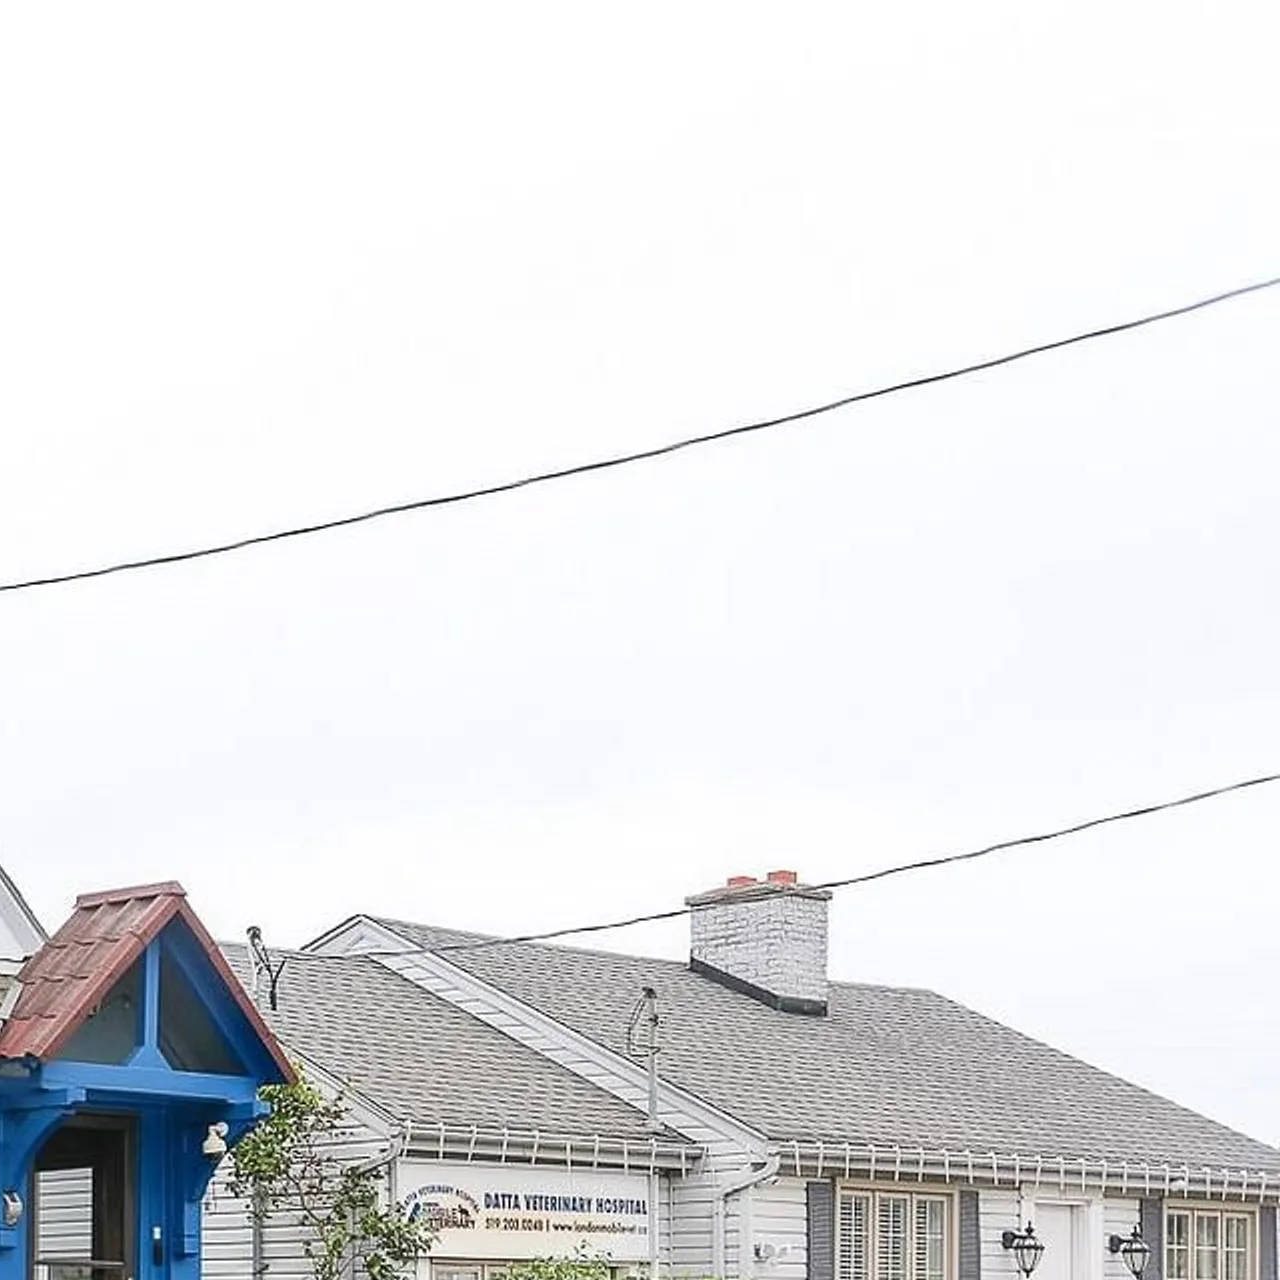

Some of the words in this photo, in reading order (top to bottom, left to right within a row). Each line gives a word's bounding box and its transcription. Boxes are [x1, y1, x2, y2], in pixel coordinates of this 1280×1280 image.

[484, 1192, 521, 1210] DATTA
[524, 1194, 591, 1213] VETERINARY
[595, 1199, 648, 1215] HOSPITAL
